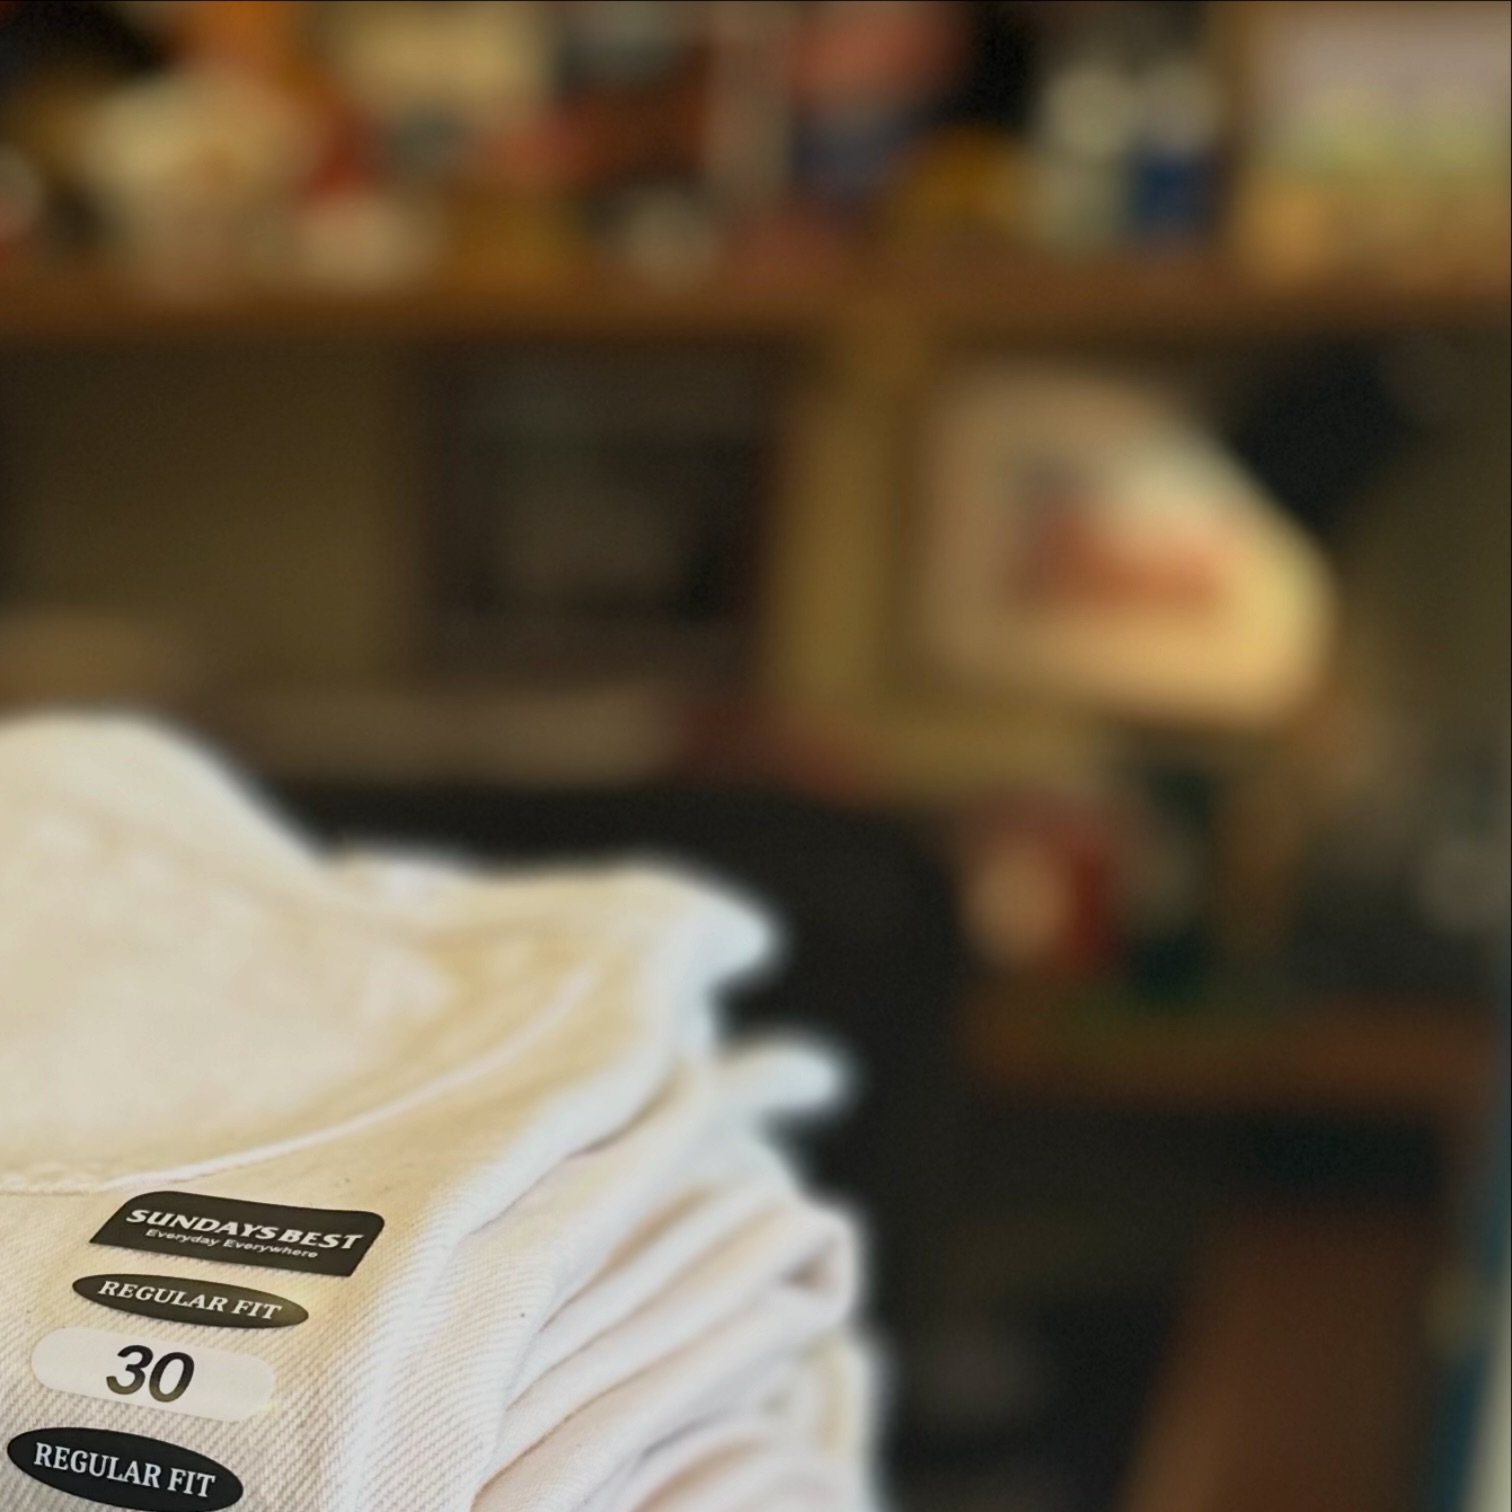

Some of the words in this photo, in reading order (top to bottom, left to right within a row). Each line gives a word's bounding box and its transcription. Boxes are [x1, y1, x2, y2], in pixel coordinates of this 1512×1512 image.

[126, 1209, 279, 1240] SUNDAYS
[279, 1229, 364, 1250] BEST
[146, 1228, 220, 1246] Everyday
[223, 1239, 318, 1258] Everywhere
[98, 1280, 228, 1312] REGULAR
[231, 1300, 282, 1320] FIT
[106, 1344, 195, 1402] 30
[34, 1442, 161, 1488] REGULAR
[168, 1469, 216, 1498] FIT
